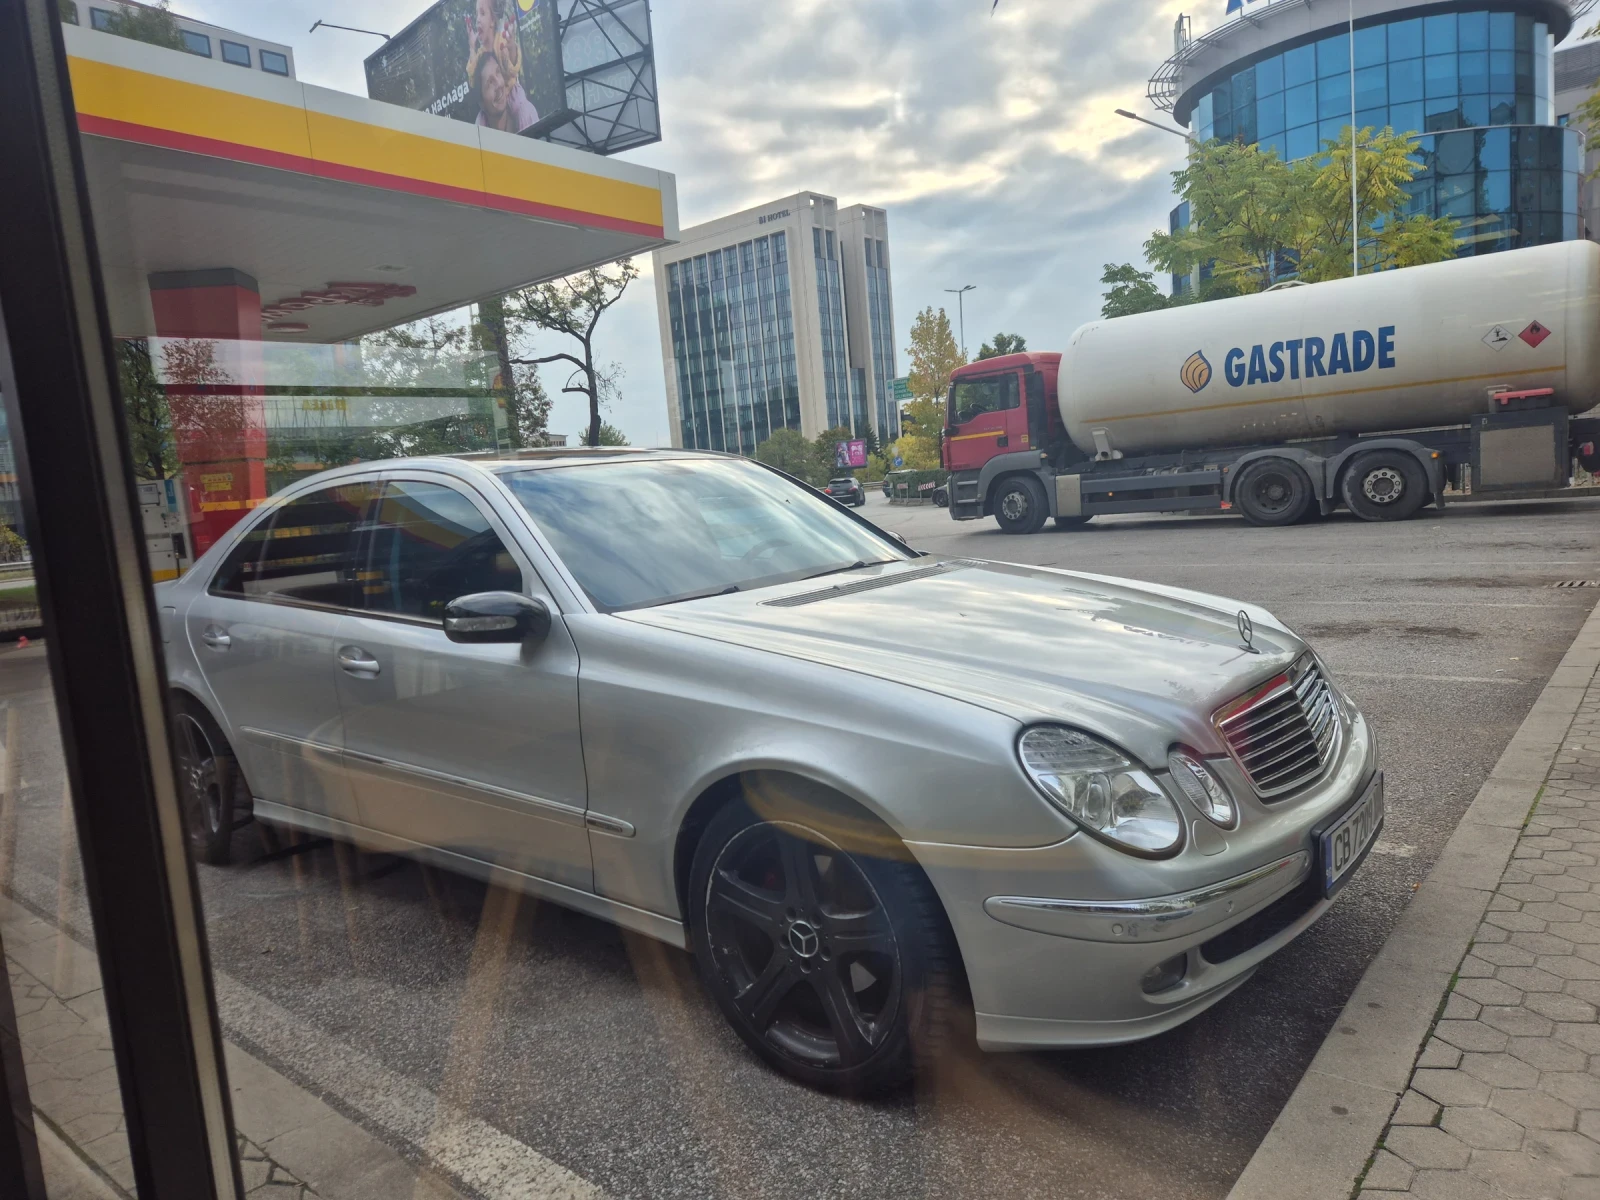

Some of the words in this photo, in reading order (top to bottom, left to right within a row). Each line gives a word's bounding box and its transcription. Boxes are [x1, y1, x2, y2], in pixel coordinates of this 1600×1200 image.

[431, 81, 470, 115] наслада
[767, 209, 791, 222] HOTEL
[1224, 325, 1396, 388] GASTRADE
